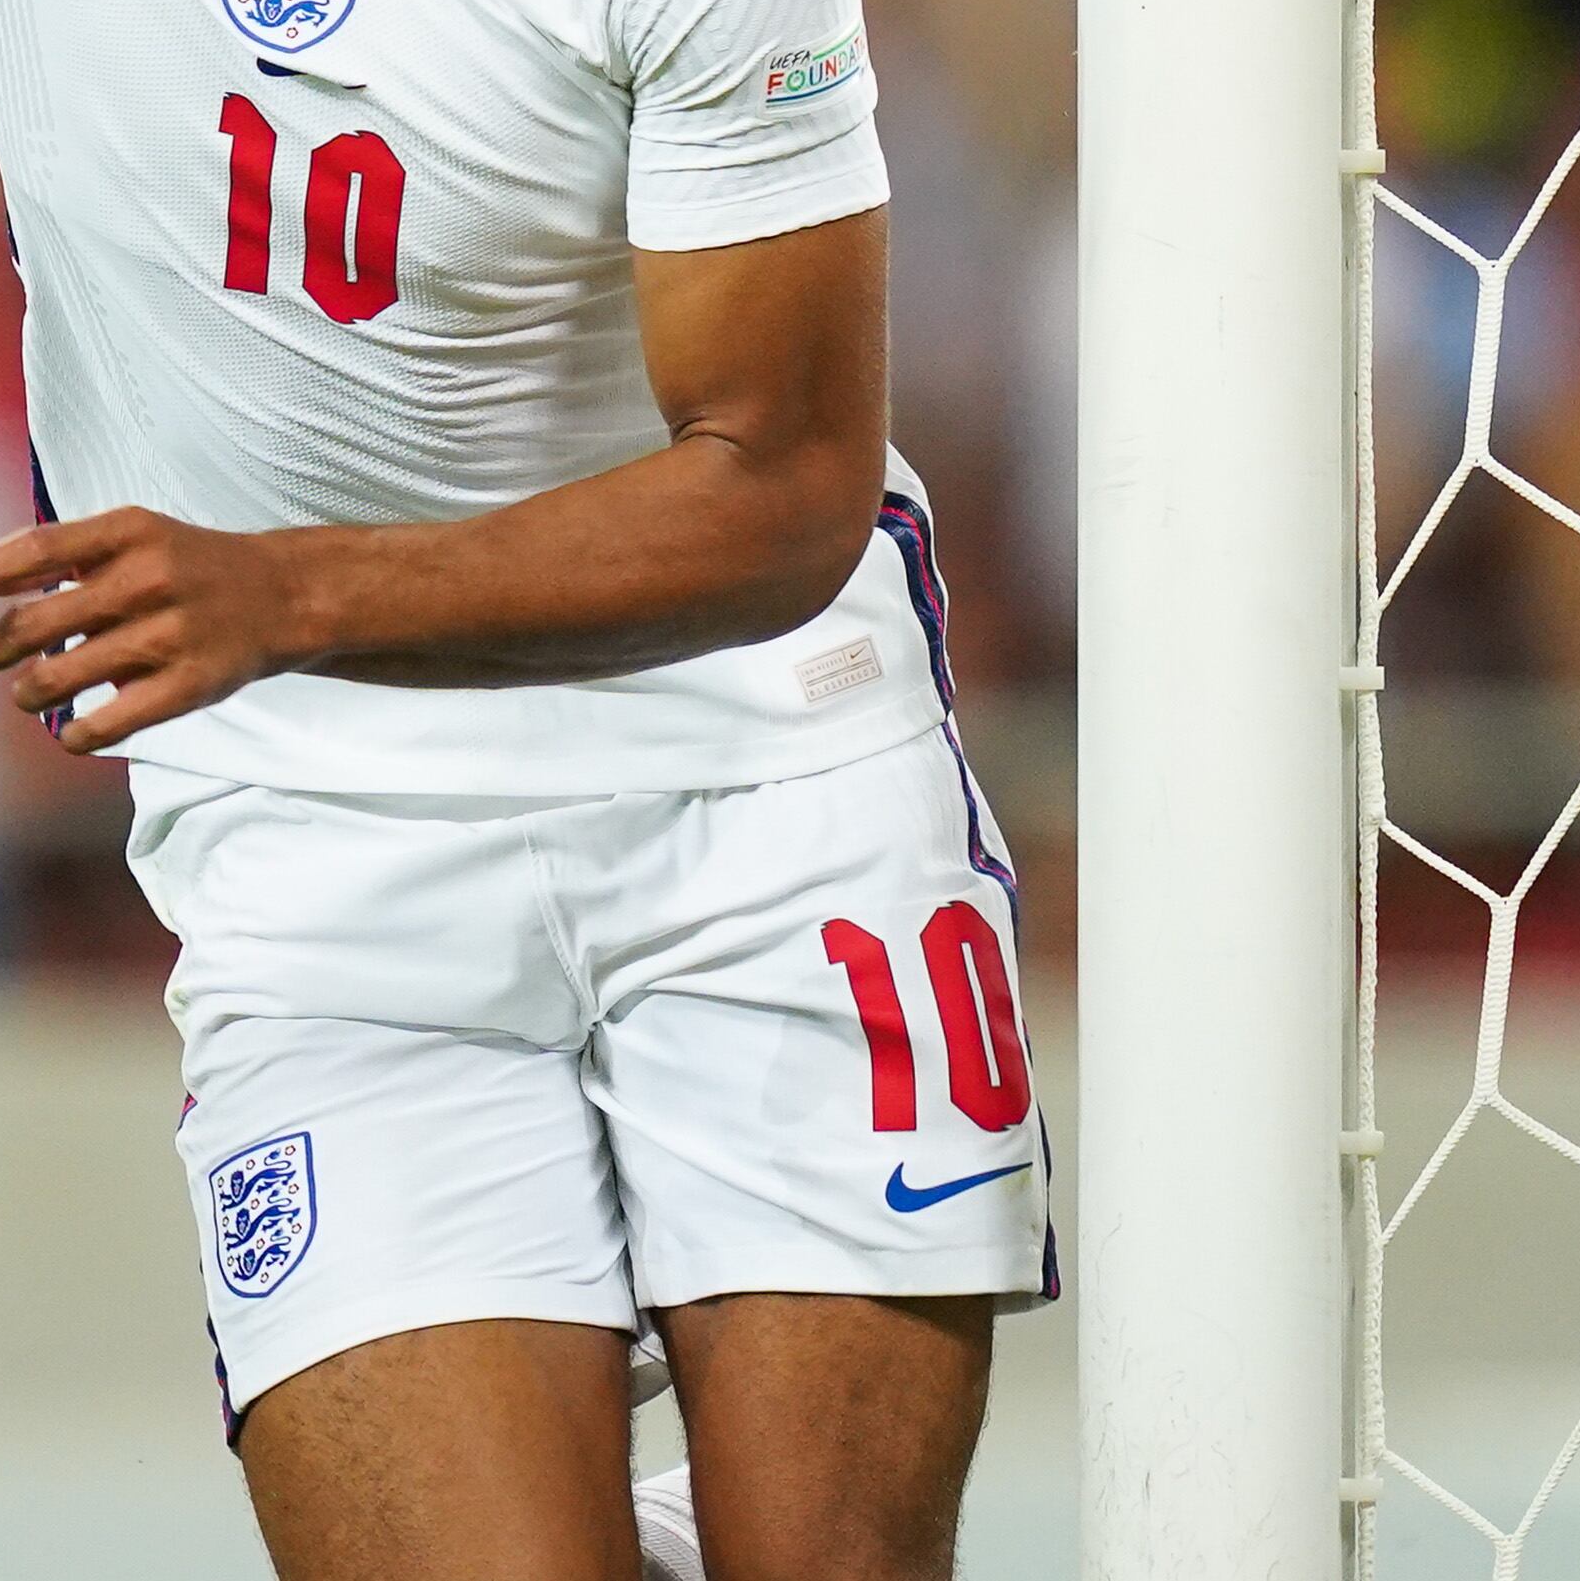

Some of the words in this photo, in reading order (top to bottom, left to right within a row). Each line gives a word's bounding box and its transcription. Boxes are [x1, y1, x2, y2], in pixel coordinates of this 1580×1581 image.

[769, 50, 811, 70] UEFA
[219, 92, 407, 325] 10
[820, 900, 1032, 1133] 10
